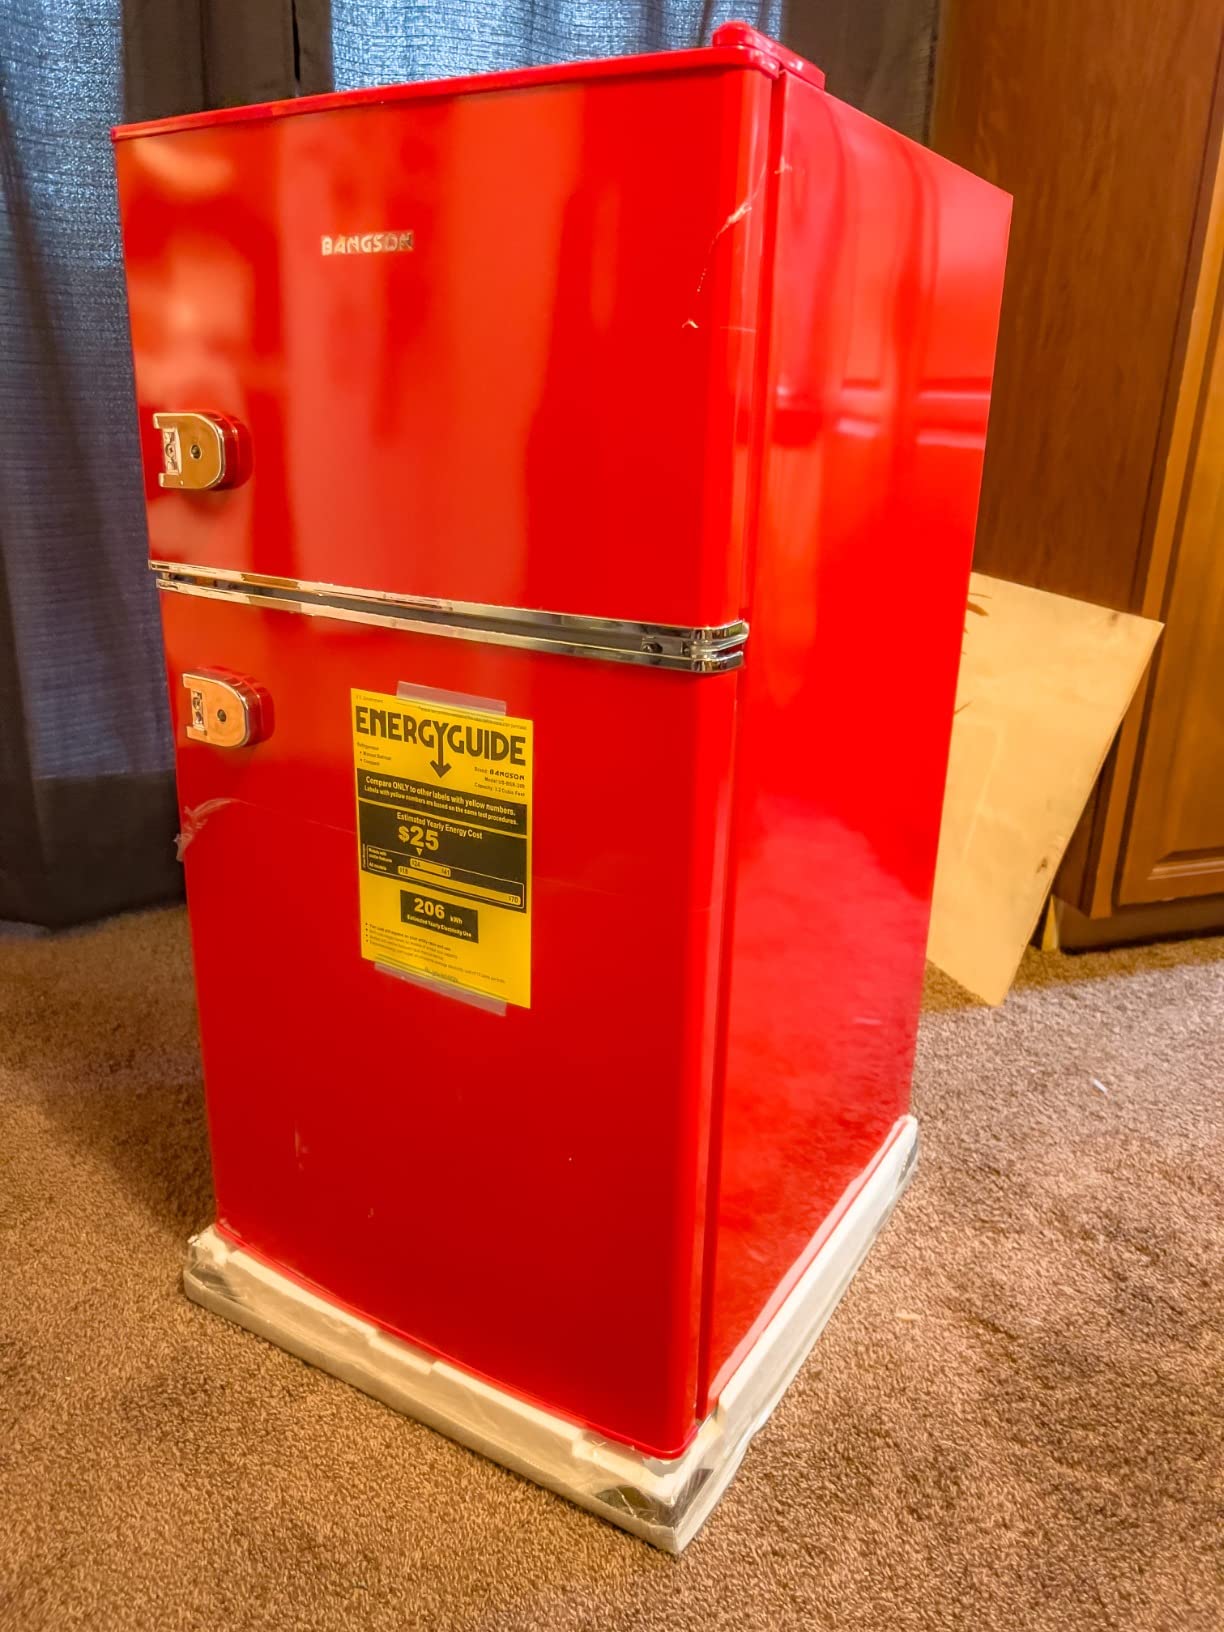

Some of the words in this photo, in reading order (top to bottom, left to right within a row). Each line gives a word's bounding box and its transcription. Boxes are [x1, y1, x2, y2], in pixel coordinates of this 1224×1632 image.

[321, 230, 414, 256] BANGSON
[355, 705, 526, 767] ENERGYGUIDE
[364, 785, 379, 794] Labels
[390, 791, 405, 799] yellow
[405, 795, 425, 804] numbers
[365, 775, 392, 788] Compare
[392, 781, 409, 791] ONLY
[410, 785, 417, 793] to
[416, 788, 432, 797] other
[432, 790, 450, 802] labels
[450, 796, 465, 805] with
[465, 799, 486, 809] yellow
[486, 804, 516, 816] numbers.
[396, 811, 425, 826] Estimated
[426, 818, 445, 832] Yearly
[445, 823, 467, 837] Energy
[467, 829, 483, 840] Cost
[398, 825, 439, 851] $25
[414, 897, 445, 920] 206
